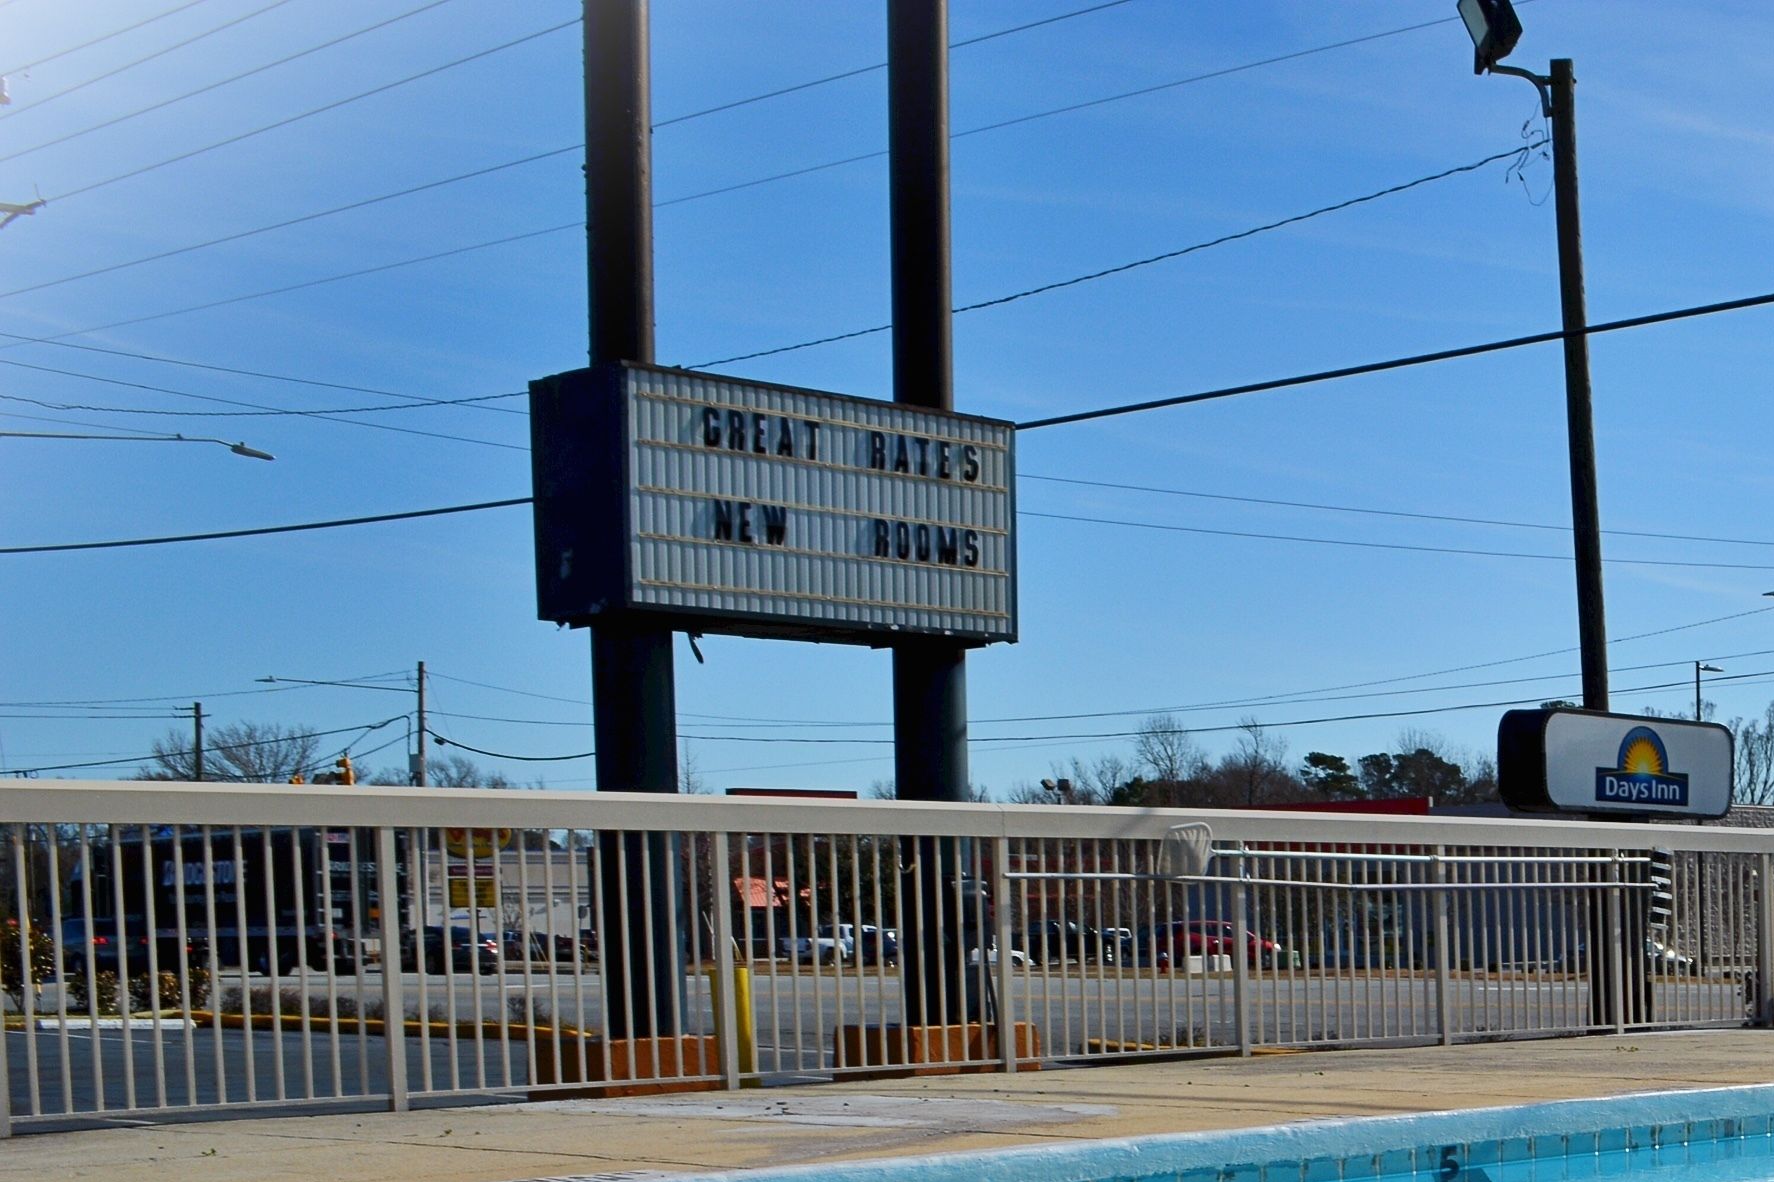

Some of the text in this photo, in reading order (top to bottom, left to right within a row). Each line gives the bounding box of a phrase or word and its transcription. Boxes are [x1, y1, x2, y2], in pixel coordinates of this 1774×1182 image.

[703, 407, 979, 482] GREAT RATES
[714, 499, 979, 566] NEW ROOMS
[1605, 776, 1680, 801] Days Inn
[1440, 1145, 1459, 1171] 5
